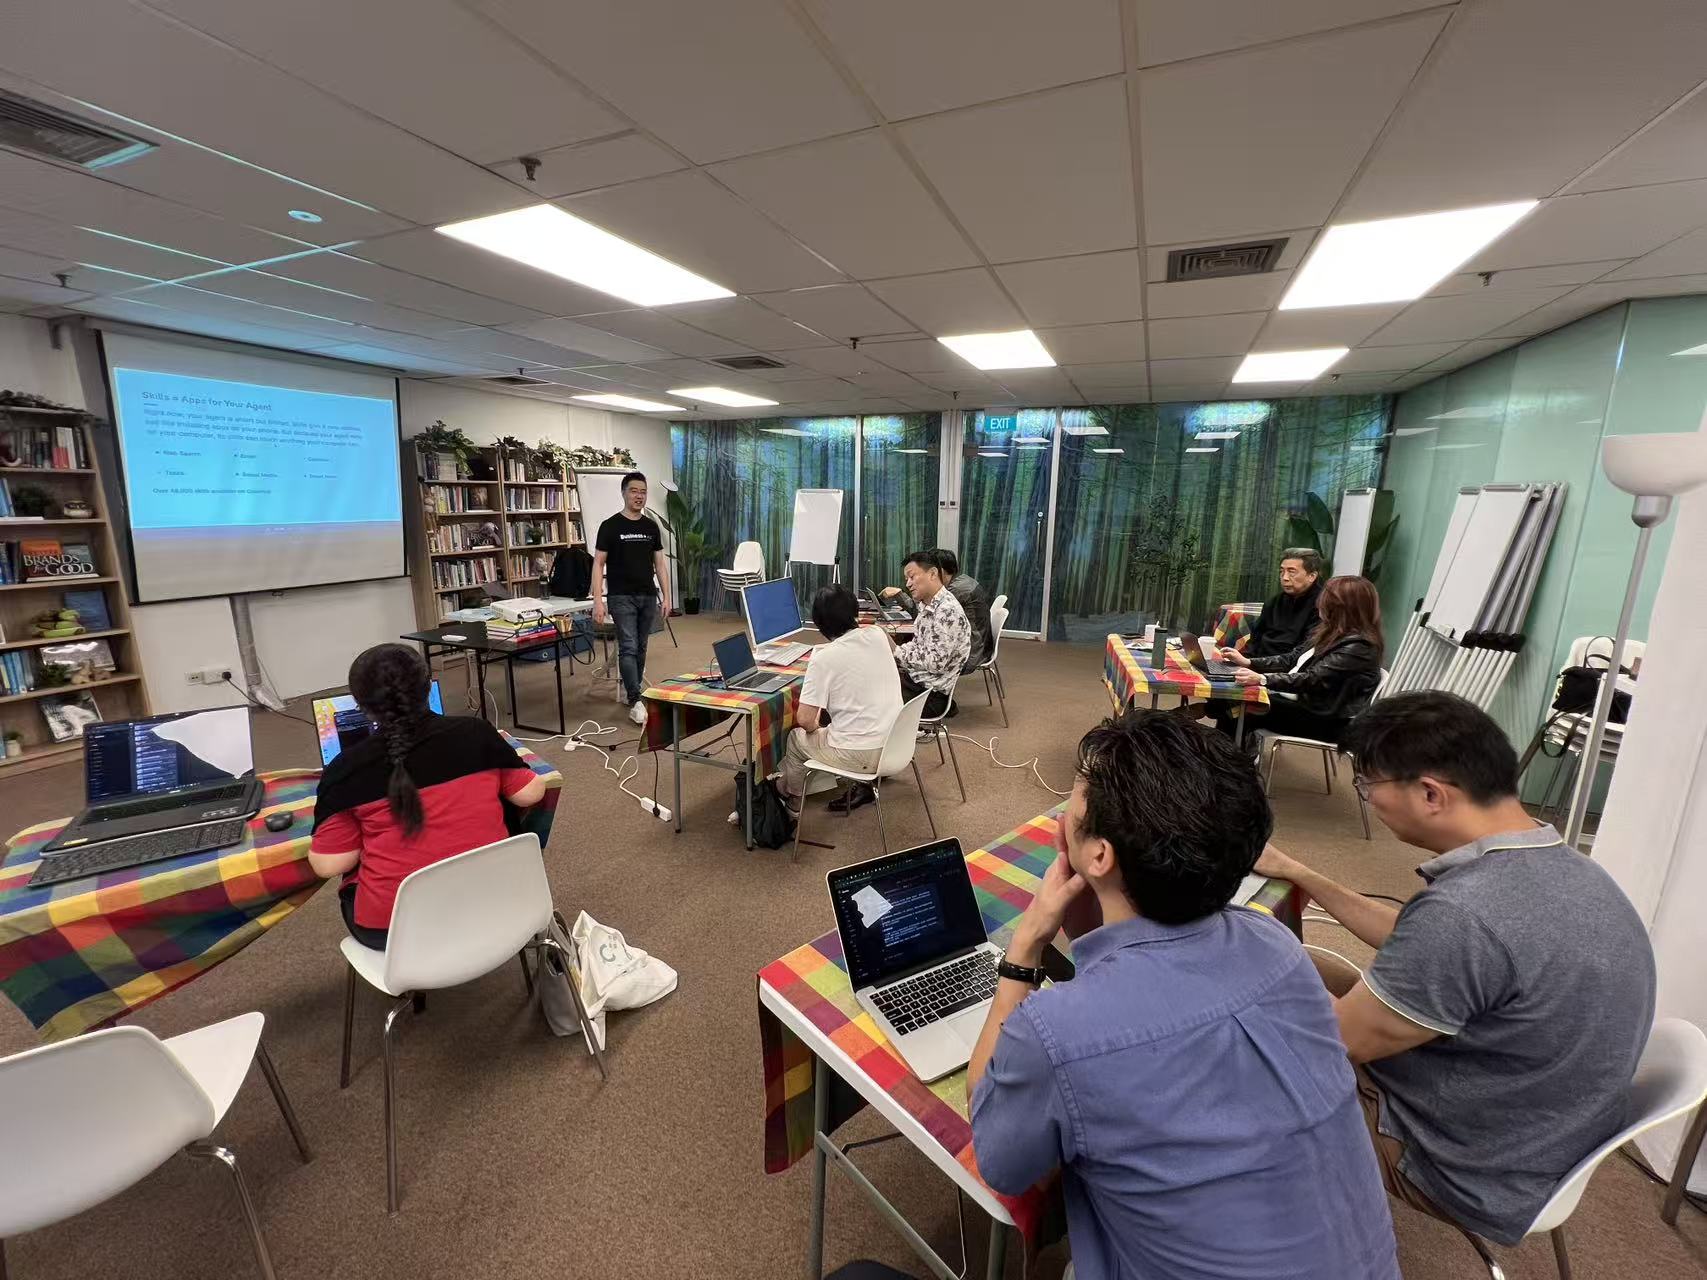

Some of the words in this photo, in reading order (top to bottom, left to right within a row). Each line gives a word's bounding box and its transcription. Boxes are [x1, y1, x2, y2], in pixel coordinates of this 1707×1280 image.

[142, 391, 170, 401] Skills
[182, 395, 207, 406] Apps
[208, 396, 221, 406] for
[224, 399, 244, 409] Your
[246, 402, 272, 412] Agent
[990, 417, 1011, 430] EXIT
[23, 555, 80, 566] BRANDS
[45, 562, 94, 576] GOOD
